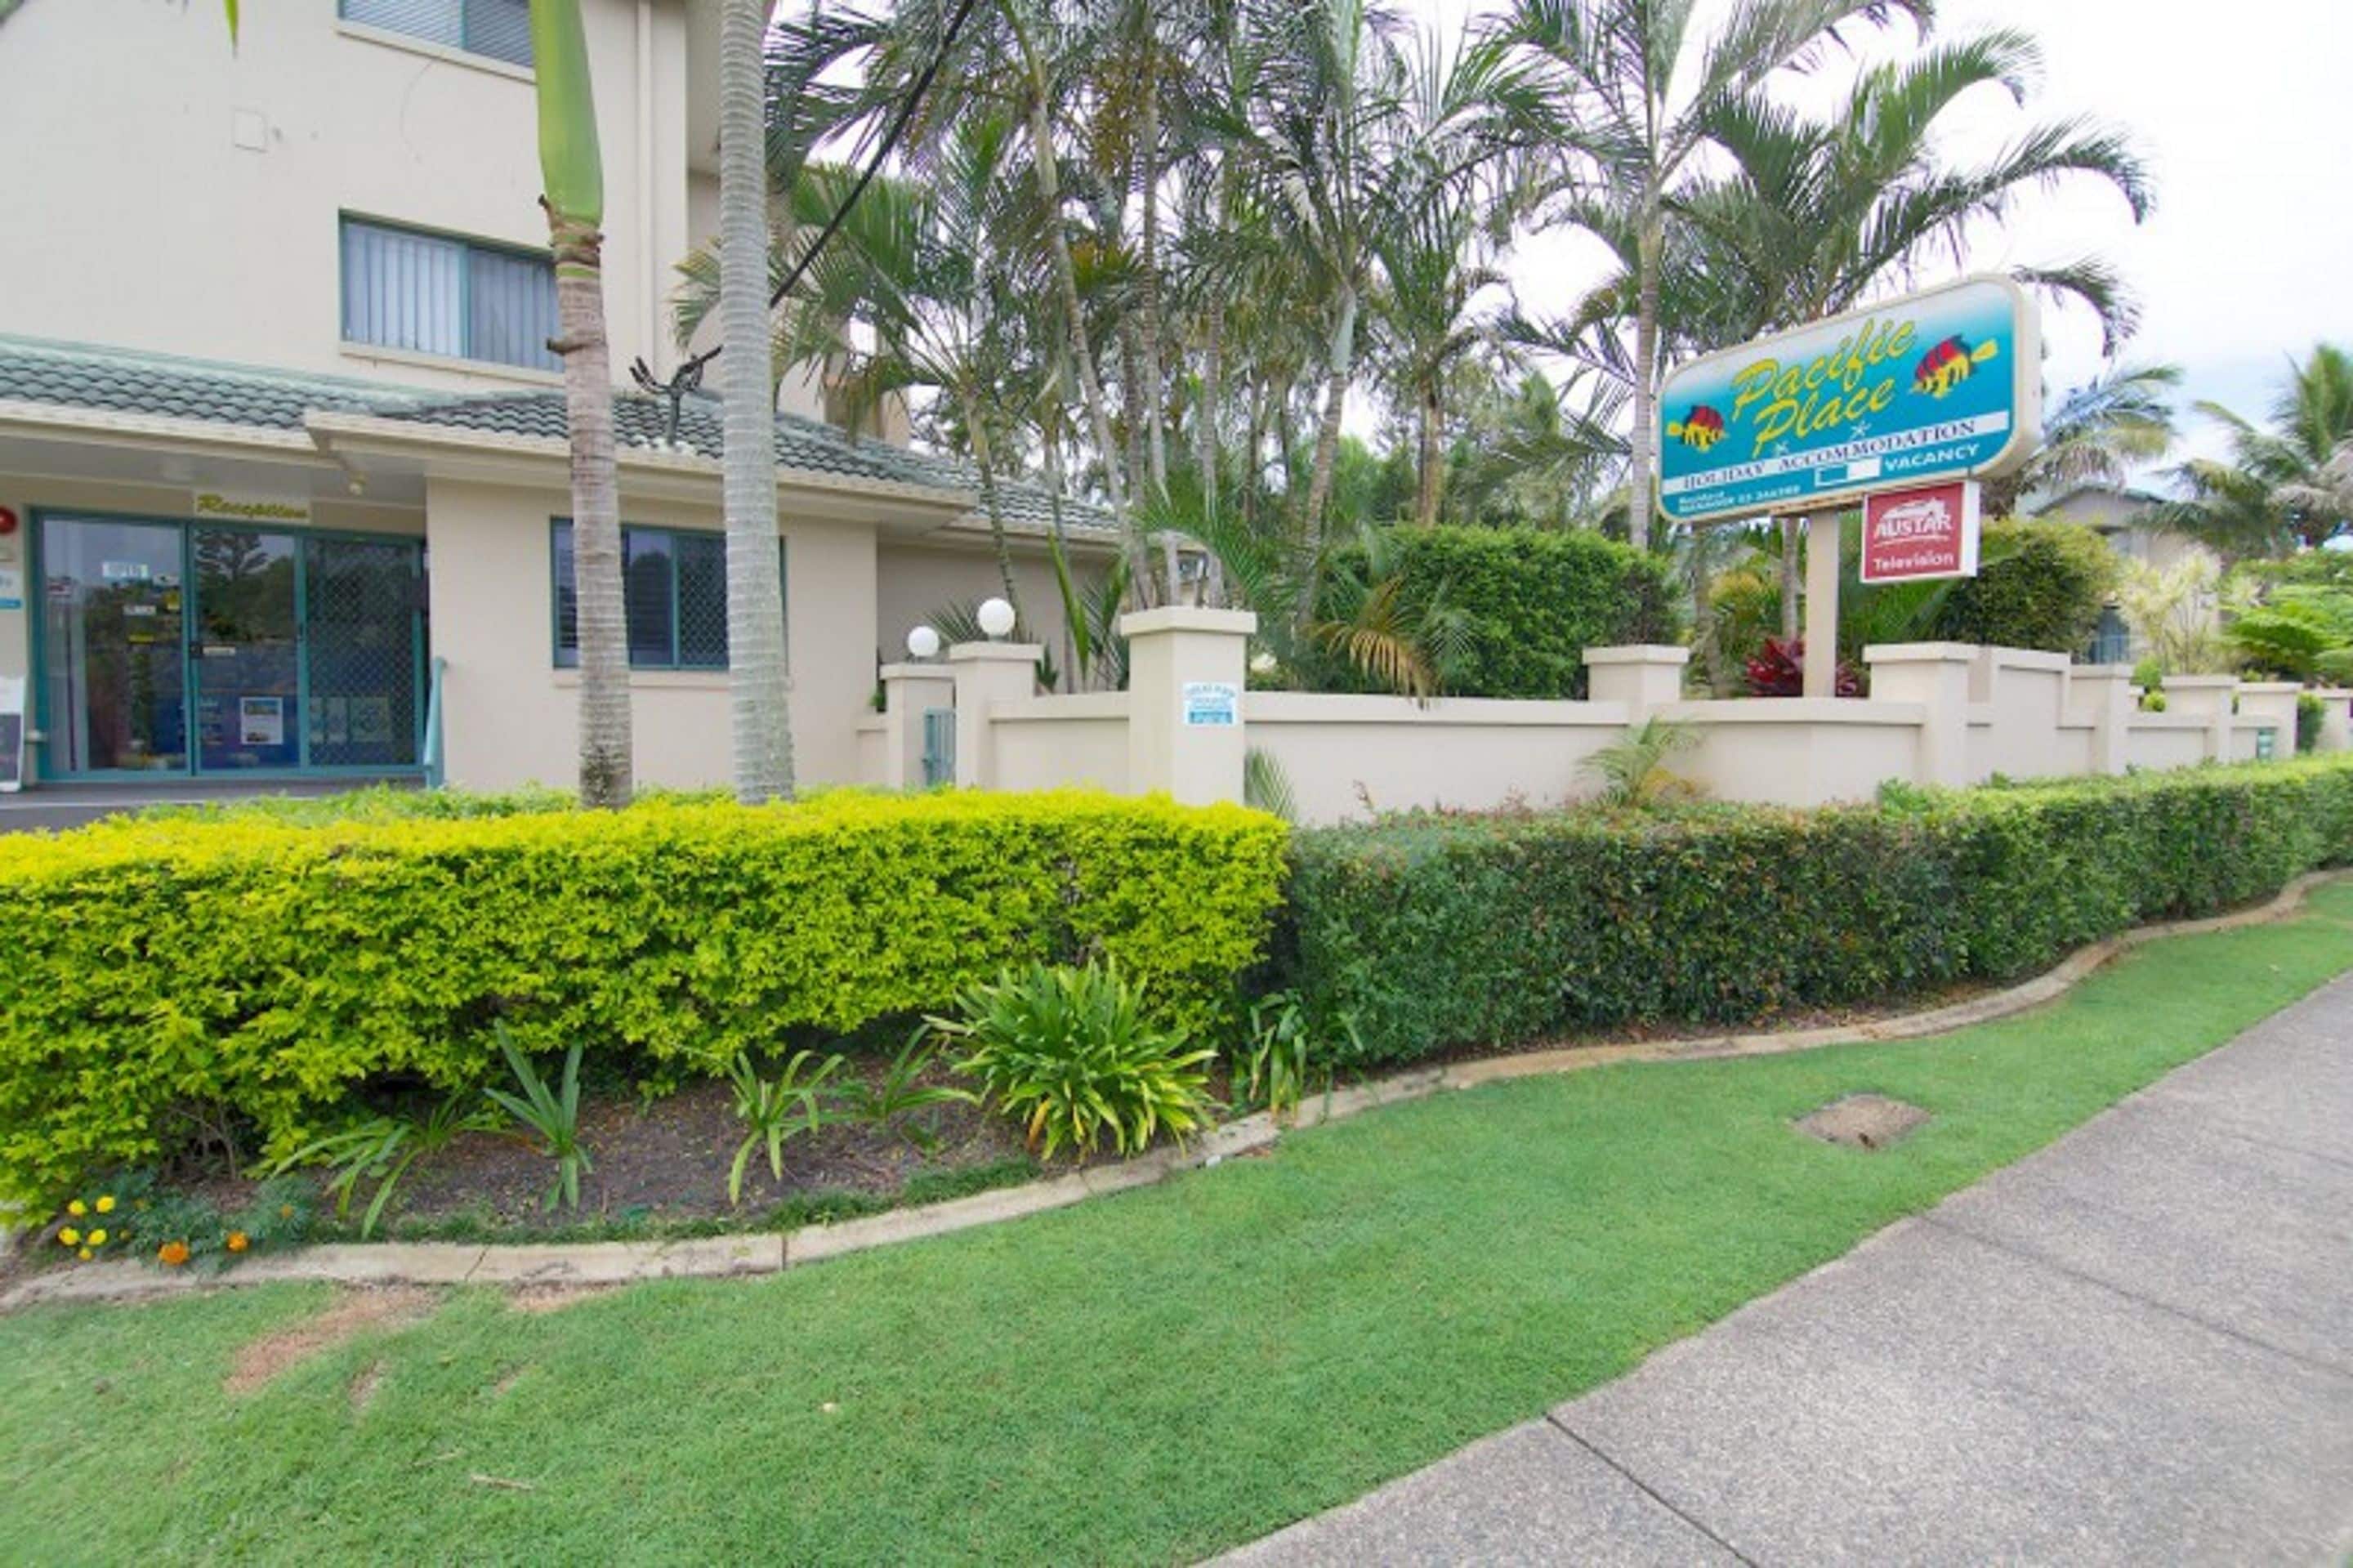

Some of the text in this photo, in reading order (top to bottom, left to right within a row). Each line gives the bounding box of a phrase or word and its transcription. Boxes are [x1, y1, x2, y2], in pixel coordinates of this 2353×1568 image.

[1730, 317, 1916, 423] Pacific
[1752, 377, 1895, 459] Place
[1684, 419, 1976, 490] HOLIDAY ACCOMMODATION
[1885, 443, 1980, 471] VACANCY
[196, 494, 308, 519] Reception
[1873, 513, 1953, 540] AUSTAR
[1872, 550, 1955, 572] Television
